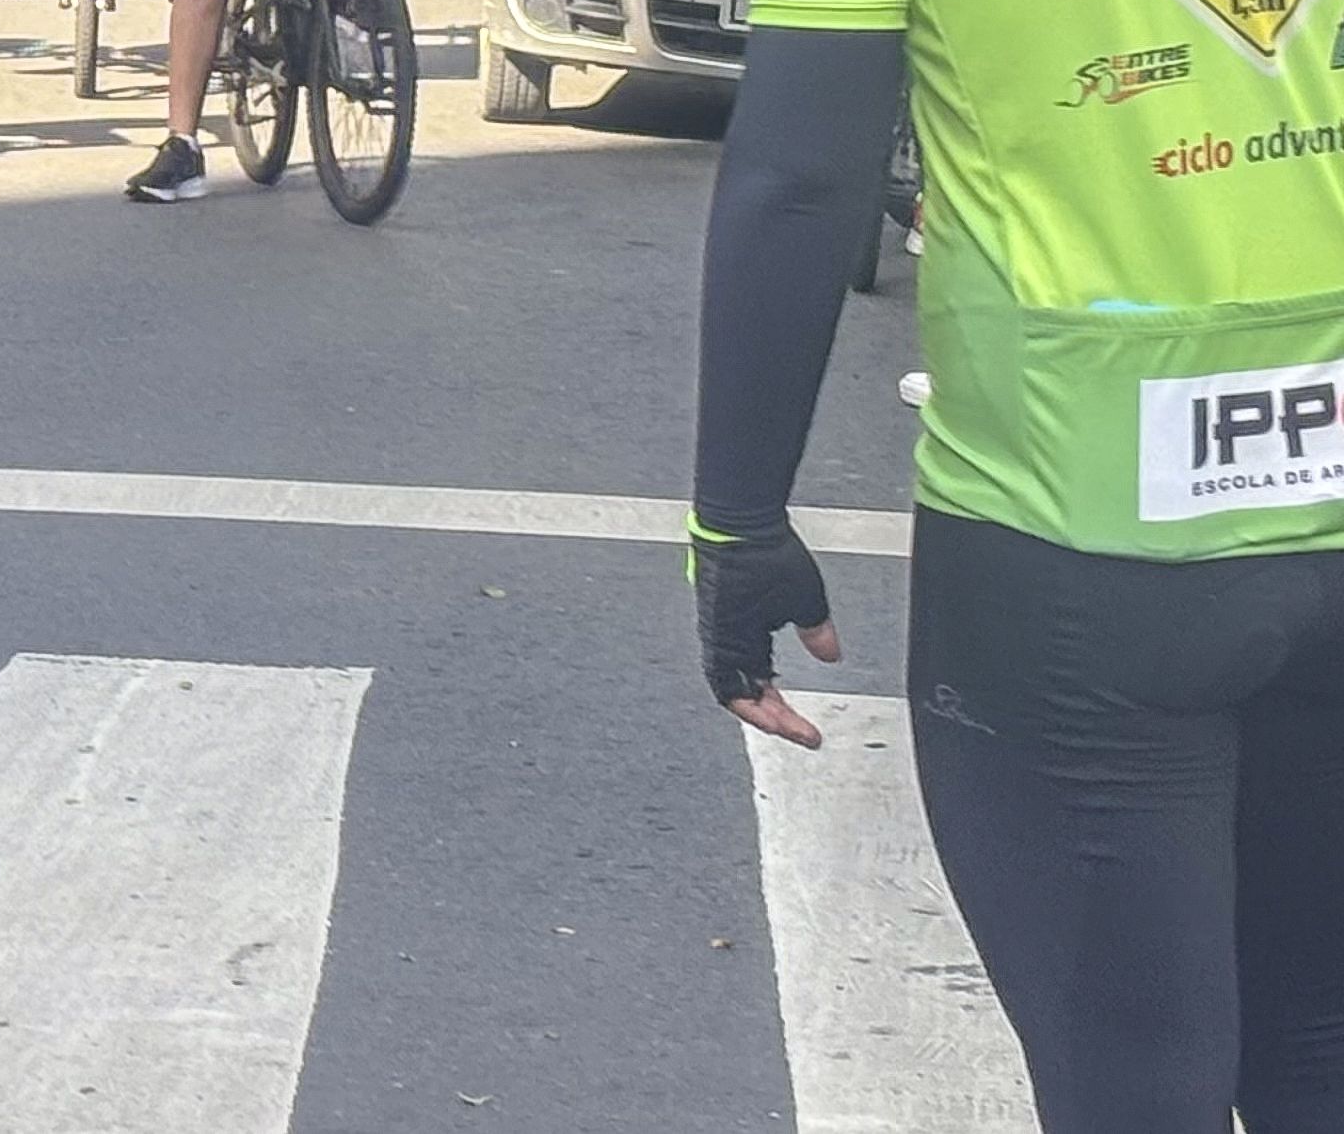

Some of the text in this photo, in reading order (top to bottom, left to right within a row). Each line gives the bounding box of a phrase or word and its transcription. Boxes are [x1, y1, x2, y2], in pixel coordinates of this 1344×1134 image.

[1110, 43, 1192, 70] ENTRE
[1119, 60, 1192, 86] BIKES
[1154, 131, 1234, 178] ciclo
[1191, 382, 1344, 470] IPP
[1191, 473, 1276, 497] ESCOLA
[1284, 469, 1313, 486] DE
